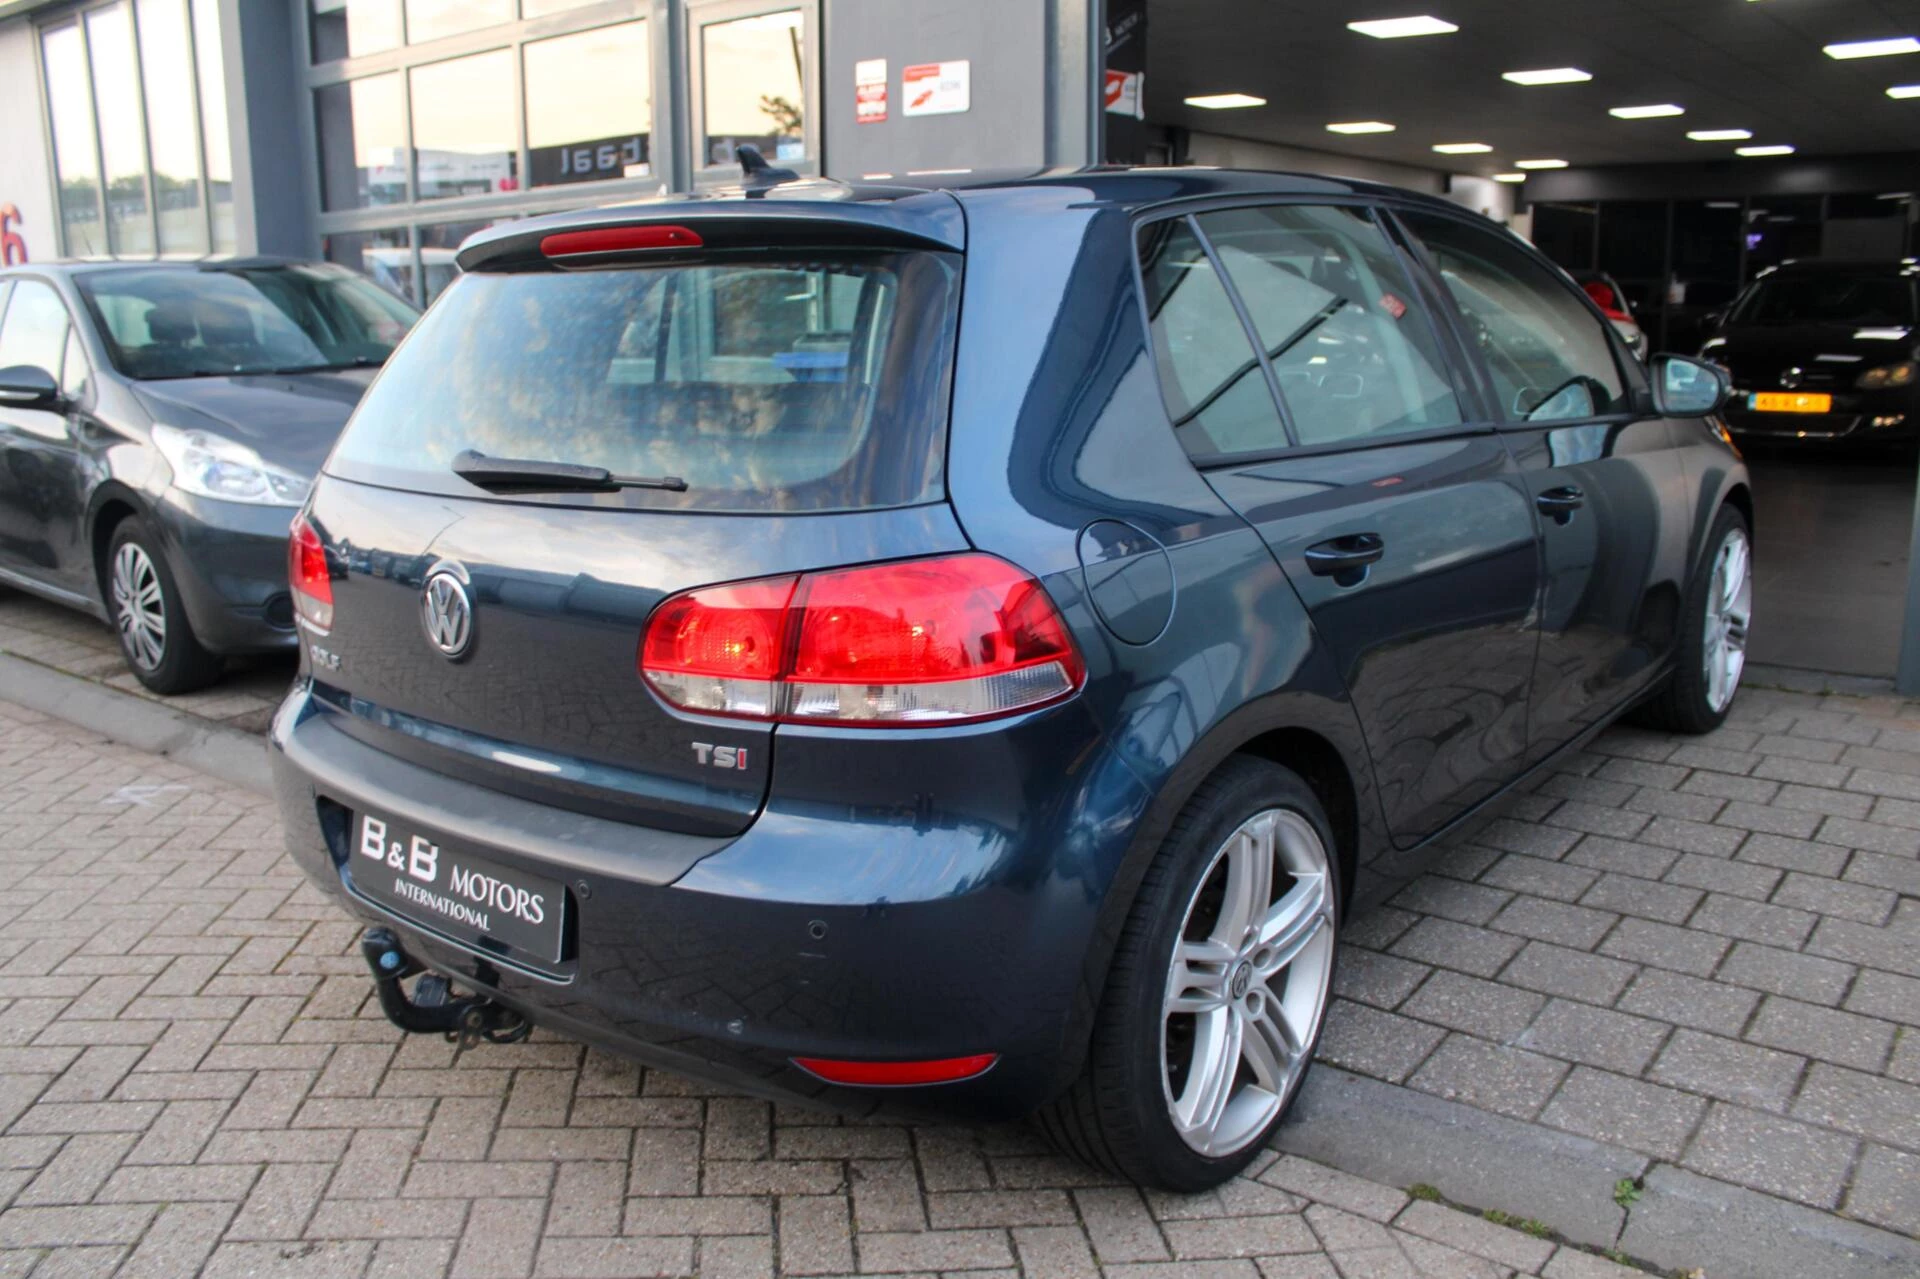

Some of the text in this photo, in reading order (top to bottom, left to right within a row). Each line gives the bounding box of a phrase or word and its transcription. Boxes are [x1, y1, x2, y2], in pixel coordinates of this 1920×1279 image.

[691, 741, 748, 770] TSI
[395, 878, 491, 931] INTERNATIONAL
[450, 864, 544, 925] MOTORS
